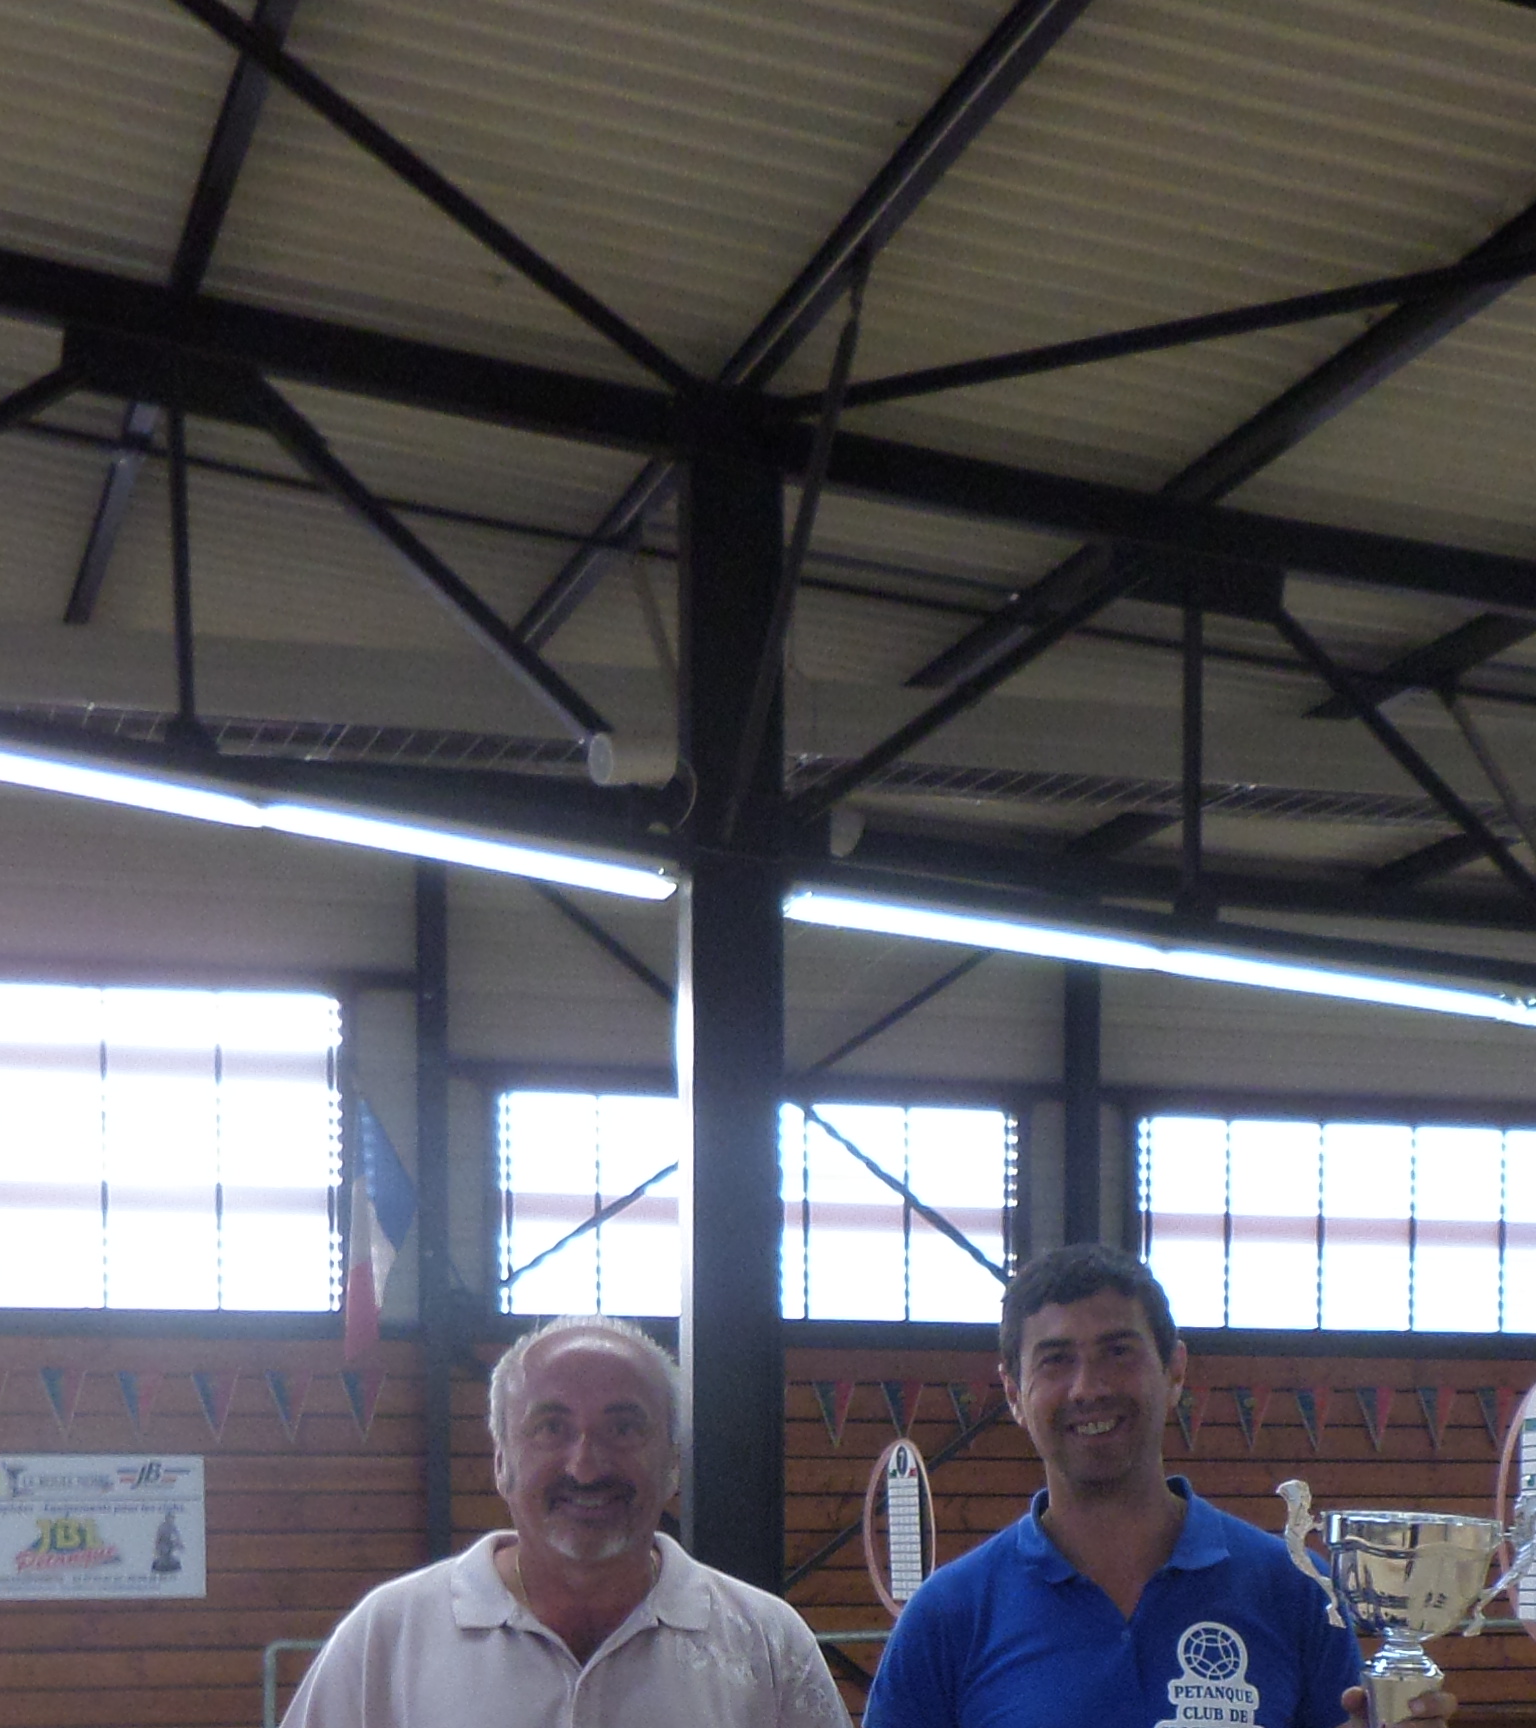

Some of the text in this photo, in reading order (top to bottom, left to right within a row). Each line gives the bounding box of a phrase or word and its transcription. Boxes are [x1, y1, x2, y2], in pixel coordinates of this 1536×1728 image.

[1174, 1686, 1253, 1703] PETANQUE
[1183, 1706, 1248, 1723] CLUB DE
